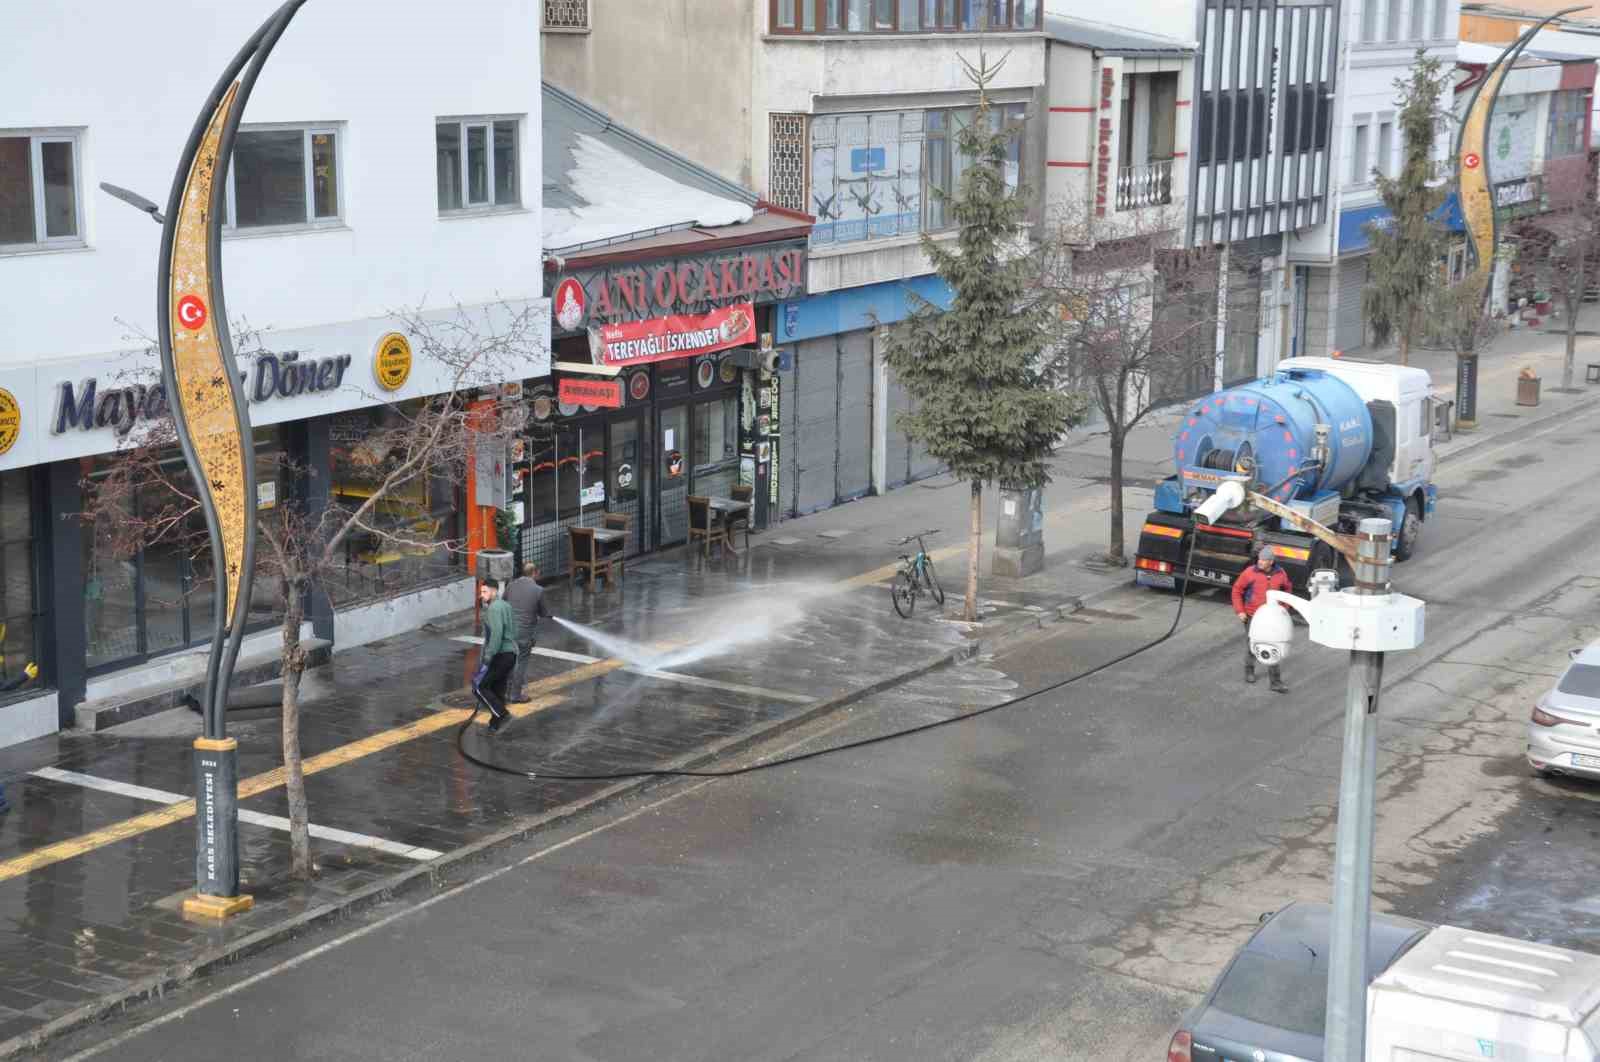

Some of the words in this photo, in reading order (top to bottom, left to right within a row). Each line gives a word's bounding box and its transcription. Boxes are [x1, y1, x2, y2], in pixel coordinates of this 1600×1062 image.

[655, 249, 802, 309] OCAKBAŞI
[607, 333, 665, 361] TEREYAĞLI
[666, 327, 720, 352] İSKENDER
[252, 350, 351, 402] Döner
[205, 772, 215, 844] BELEDİYESİ
[207, 848, 215, 880] KARS
